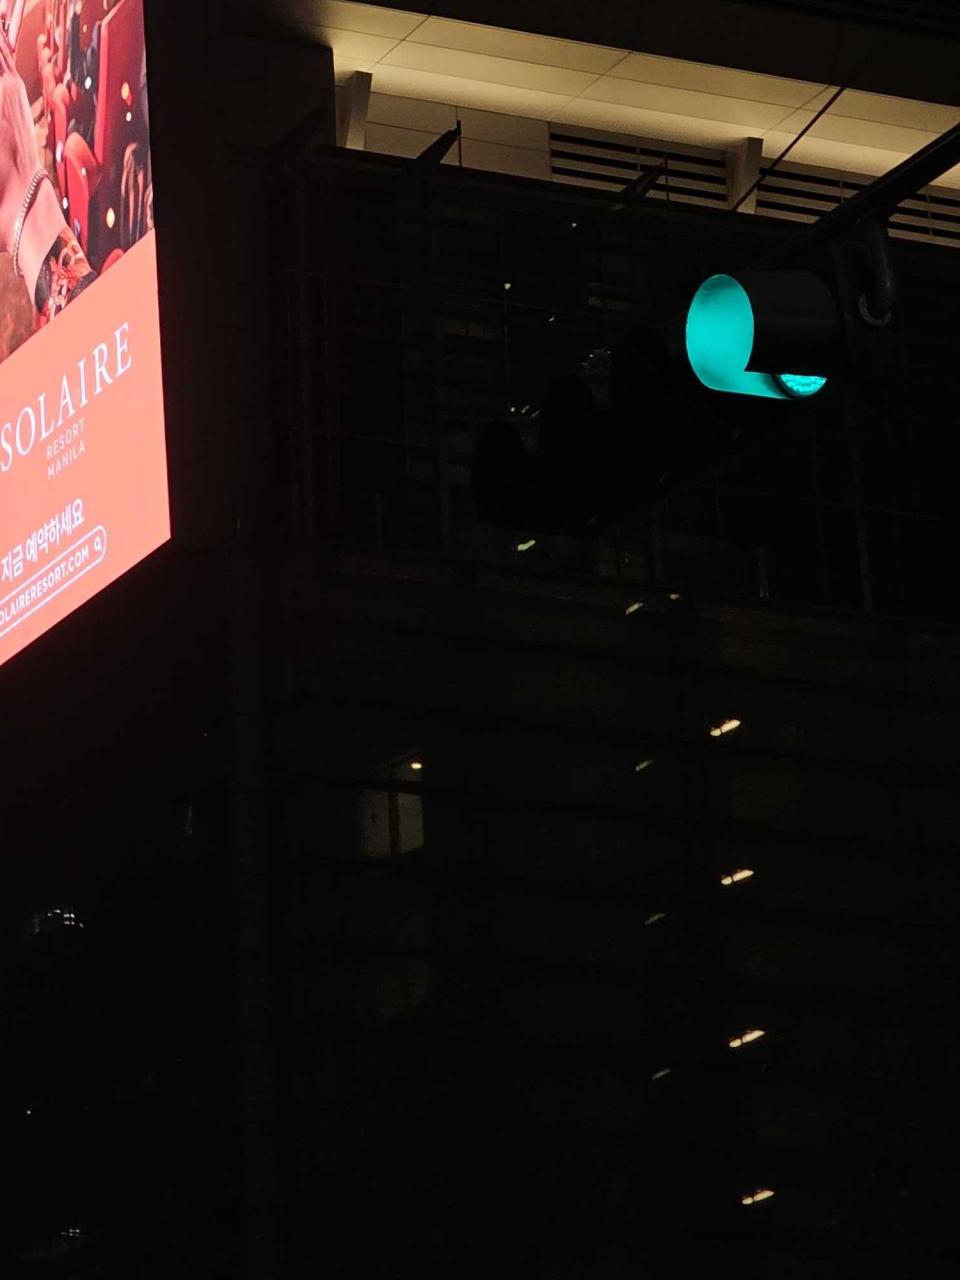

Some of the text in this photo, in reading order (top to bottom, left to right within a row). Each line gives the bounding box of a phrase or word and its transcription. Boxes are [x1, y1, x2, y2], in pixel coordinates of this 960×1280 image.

[0, 321, 132, 472] SOLAIRE
[46, 418, 85, 459] RESORT
[47, 441, 86, 480] MANILA
[1, 498, 84, 582] 지금 예약하세요
